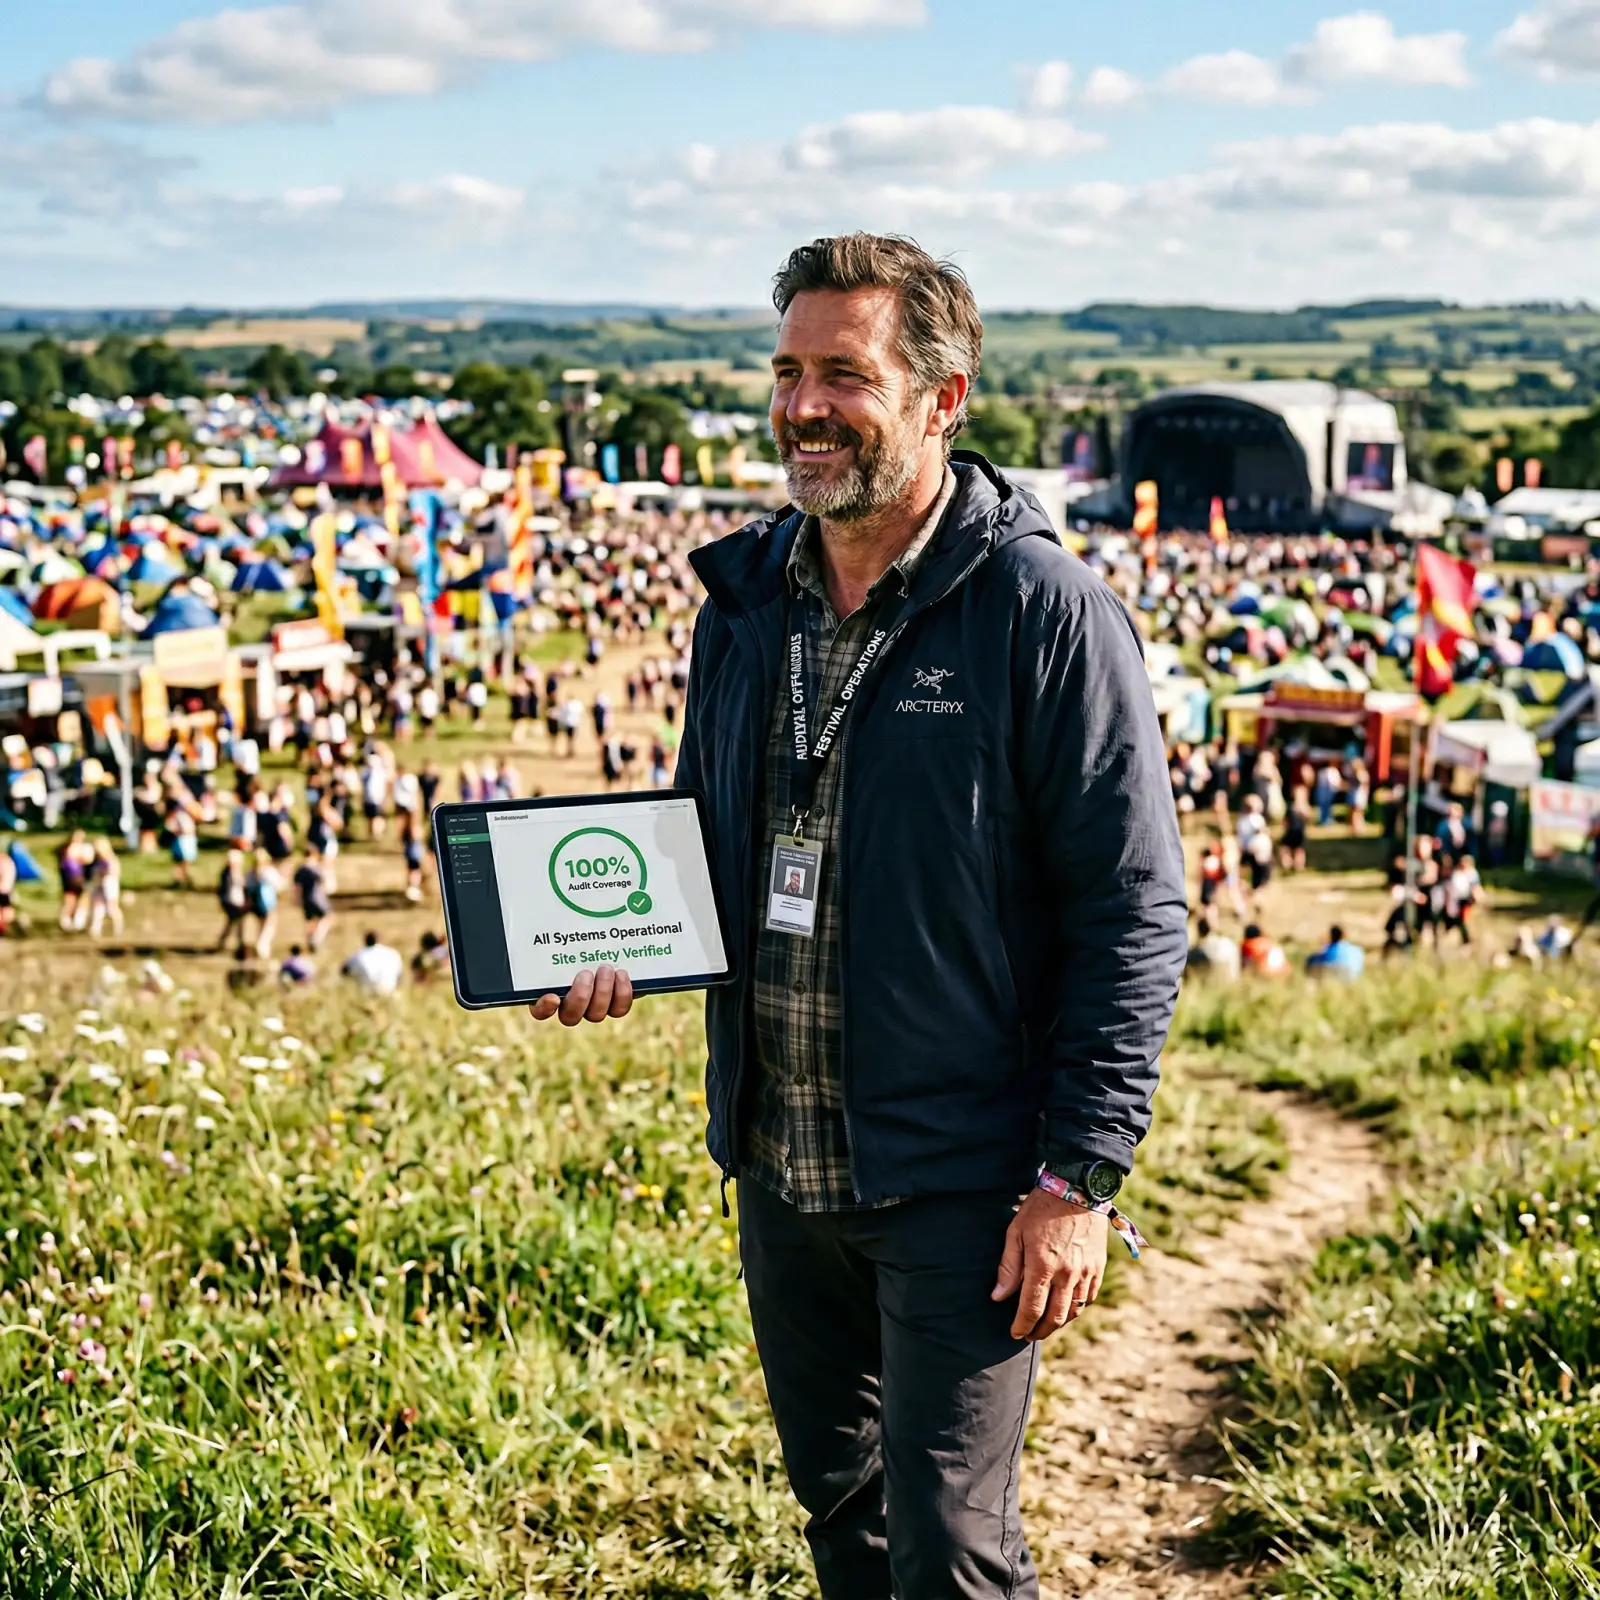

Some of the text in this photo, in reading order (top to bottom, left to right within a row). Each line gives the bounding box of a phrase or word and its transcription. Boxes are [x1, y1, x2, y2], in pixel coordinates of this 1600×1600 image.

[812, 629, 886, 759] FESTIVAL OPERATIONS
[564, 856, 630, 878] 100%
[568, 879, 632, 892] Audit Coverage
[533, 921, 683, 946] All Systems Operational
[551, 943, 673, 965] Site Safety Verified
